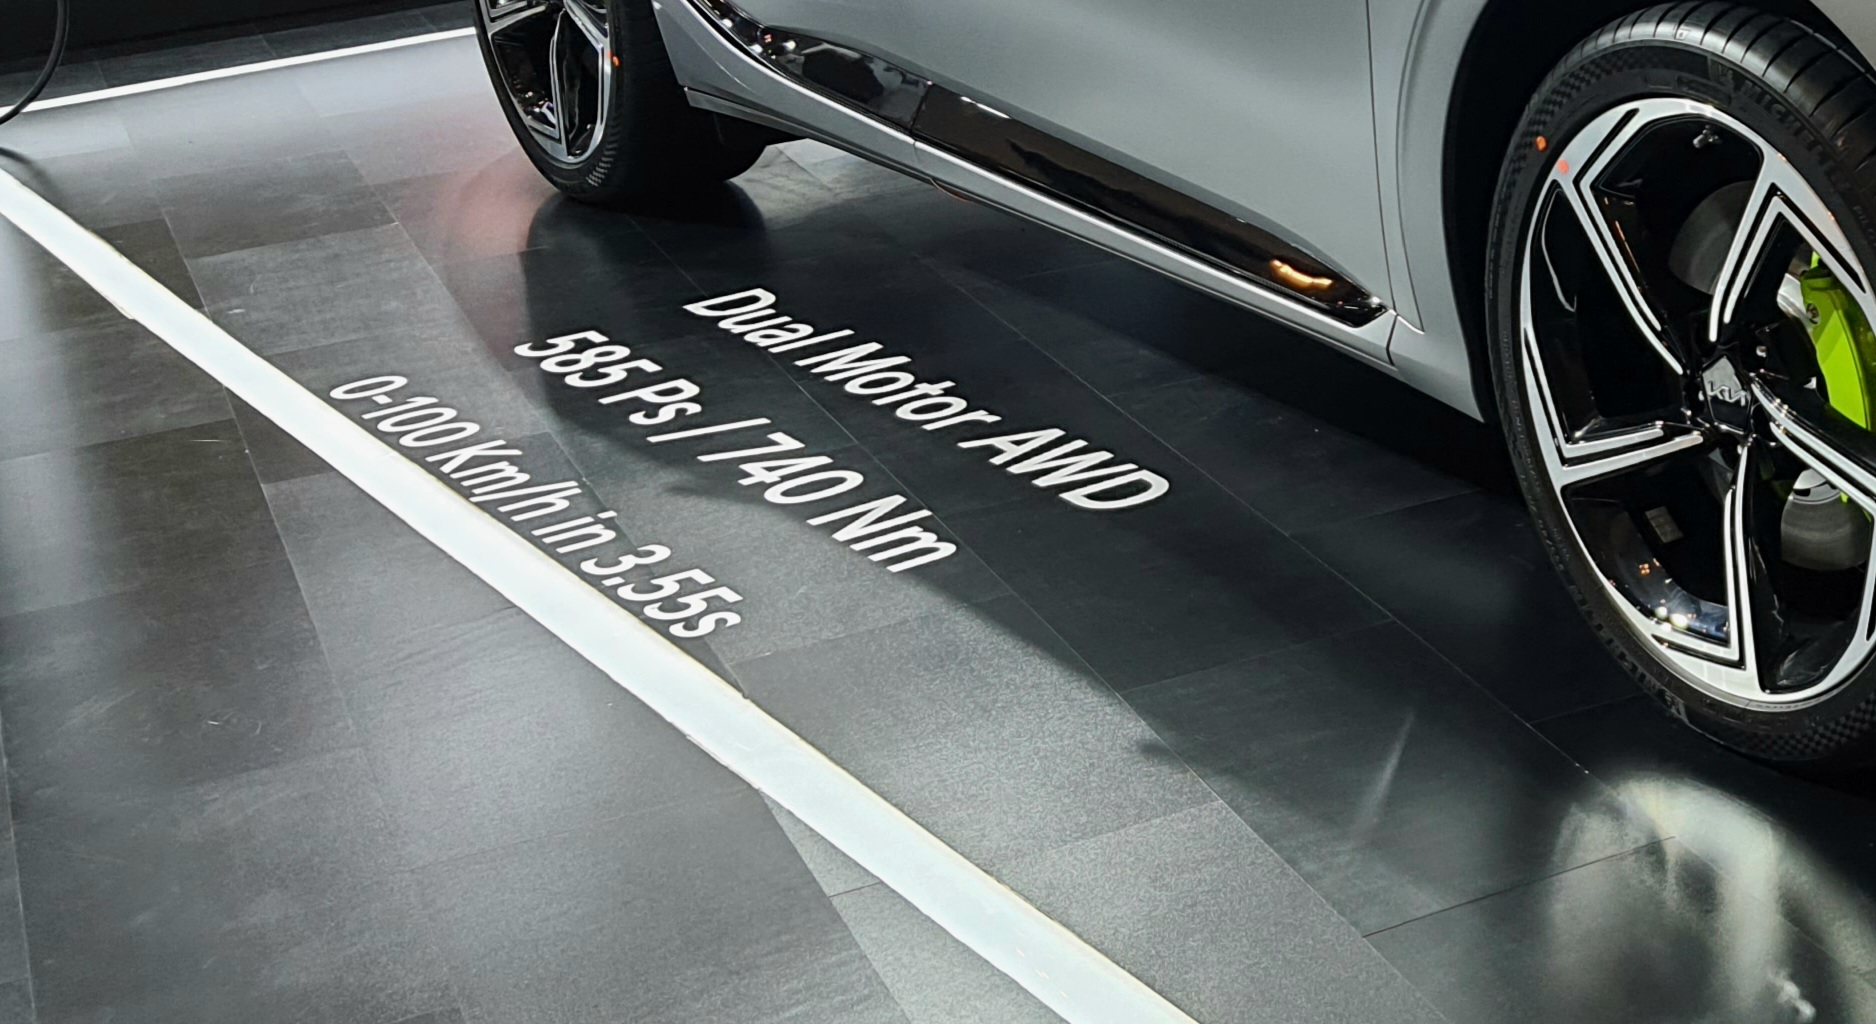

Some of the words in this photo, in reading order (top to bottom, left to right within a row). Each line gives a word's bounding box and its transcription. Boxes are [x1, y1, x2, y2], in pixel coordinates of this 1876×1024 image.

[329, 375, 481, 448] 0-100
[425, 439, 583, 522] Km/h
[531, 510, 618, 554] in
[579, 544, 744, 638] 3.55s
[513, 330, 663, 388] 585
[598, 378, 703, 425] Ps
[696, 431, 864, 504] 740
[806, 494, 957, 573] Nm
[682, 287, 856, 354] Dual
[793, 341, 1002, 431] Motor
[957, 427, 1170, 510] AWD
